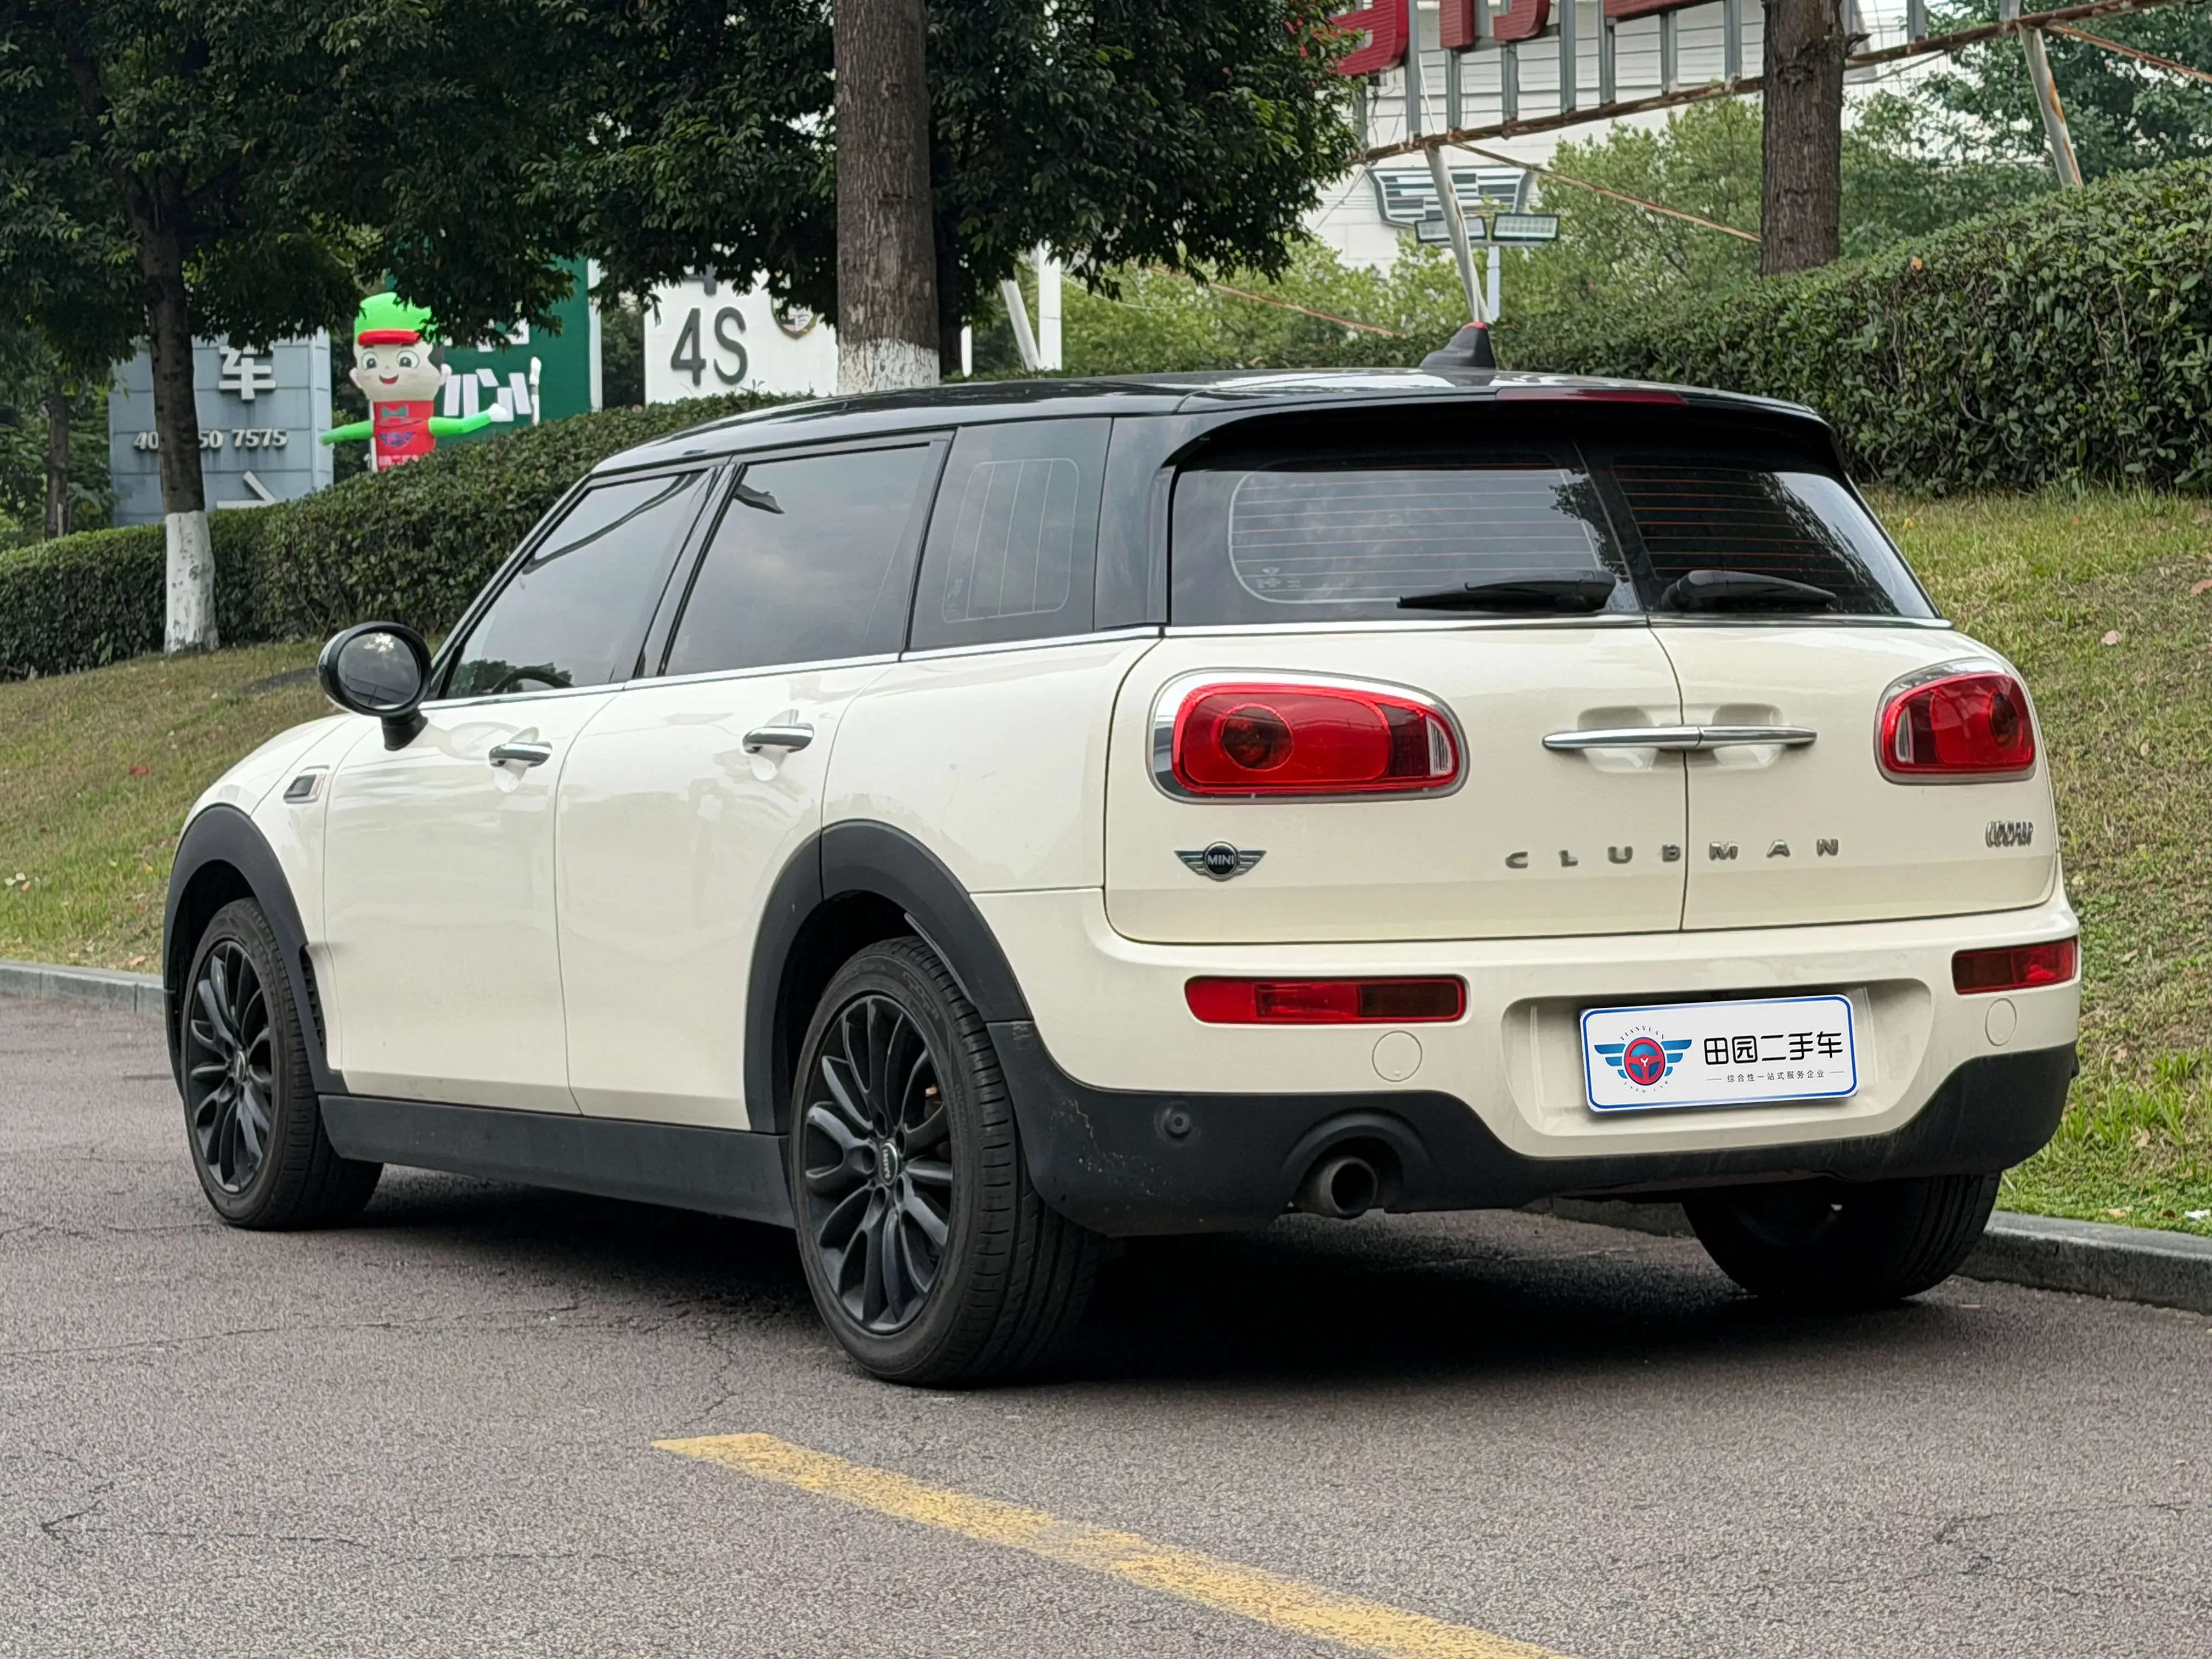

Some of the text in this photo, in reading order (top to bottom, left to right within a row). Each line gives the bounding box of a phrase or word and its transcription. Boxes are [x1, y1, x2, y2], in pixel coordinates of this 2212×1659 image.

[670, 306, 748, 386] 4S
[231, 428, 288, 448] 7575
[1207, 854, 1235, 865] MINI
[1505, 839, 1839, 869] CLUBMAN
[1704, 1031, 1843, 1065] 田园二手车
[1727, 1069, 1824, 1083] 综合性一站式服务企业
